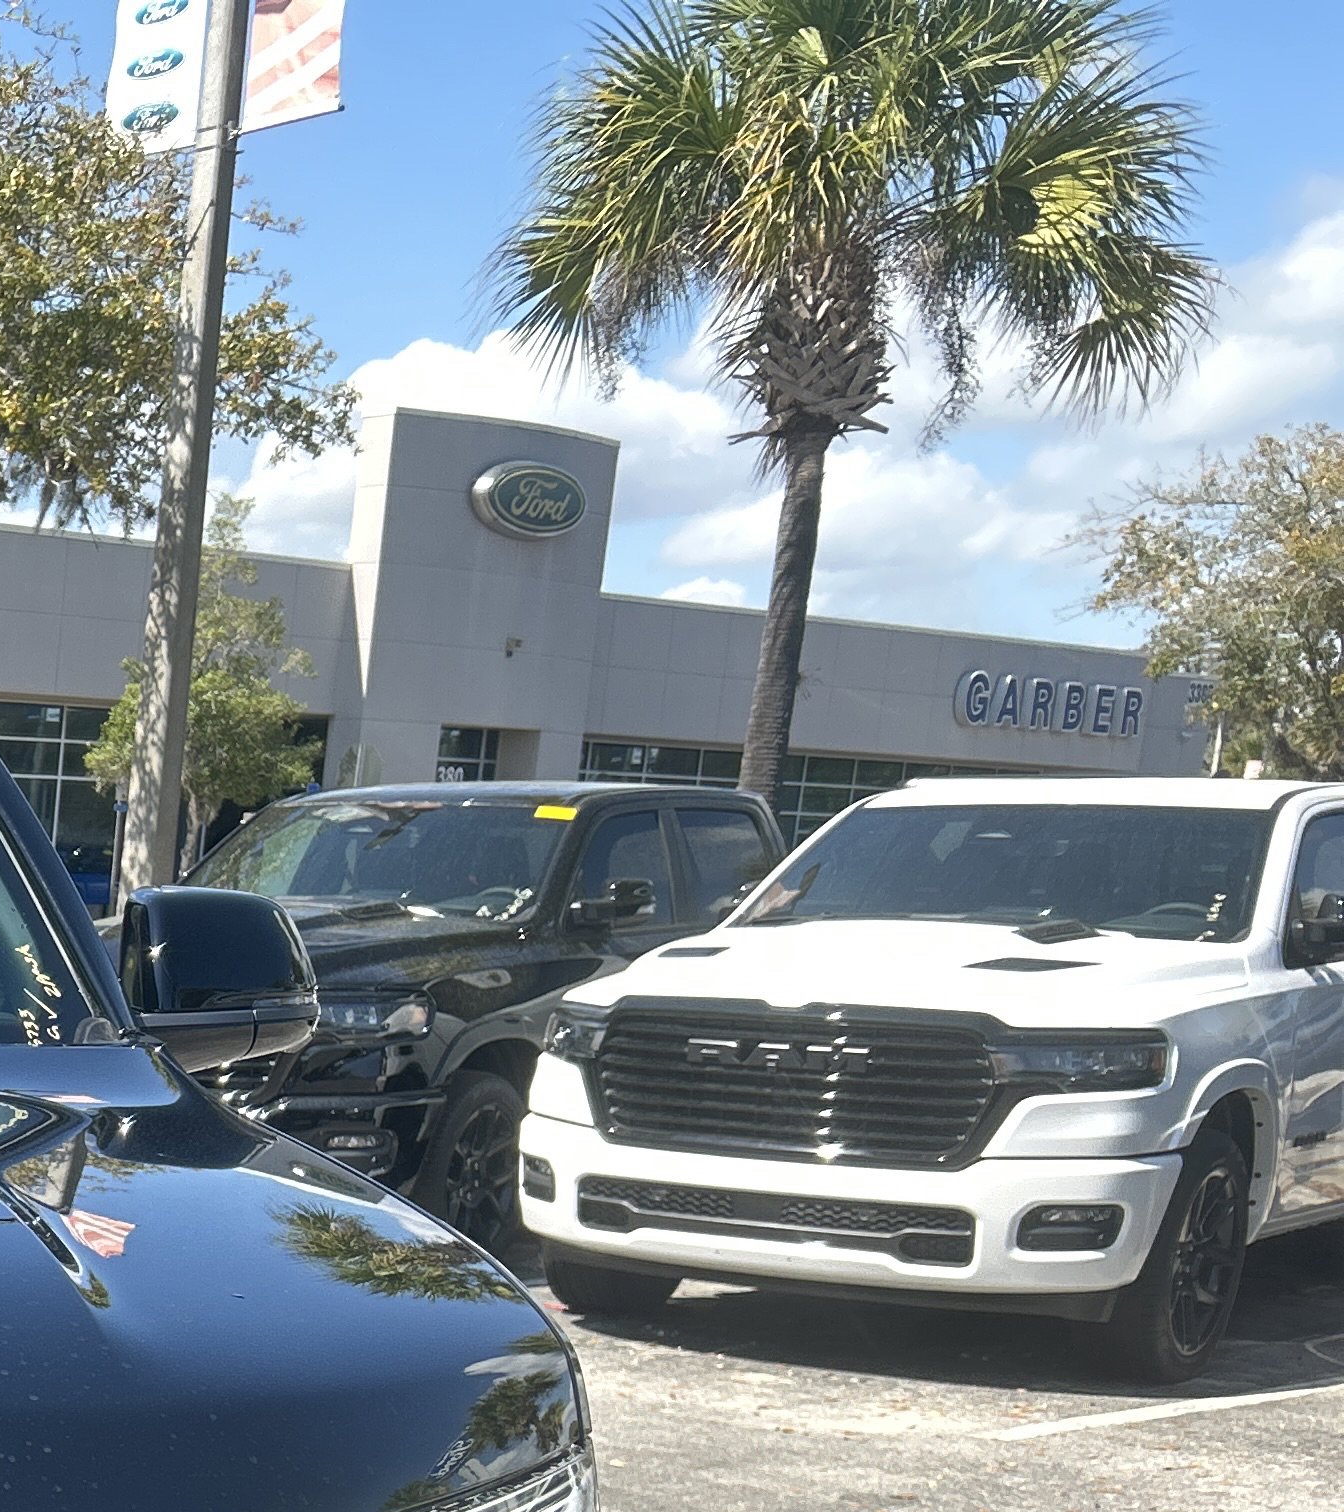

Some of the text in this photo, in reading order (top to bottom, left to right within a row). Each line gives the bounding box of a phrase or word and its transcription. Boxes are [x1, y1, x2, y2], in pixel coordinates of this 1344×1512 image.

[133, 51, 175, 78] Ford
[512, 477, 572, 522] Ford
[961, 669, 1144, 737] GARBER
[687, 1038, 871, 1073] RAM
